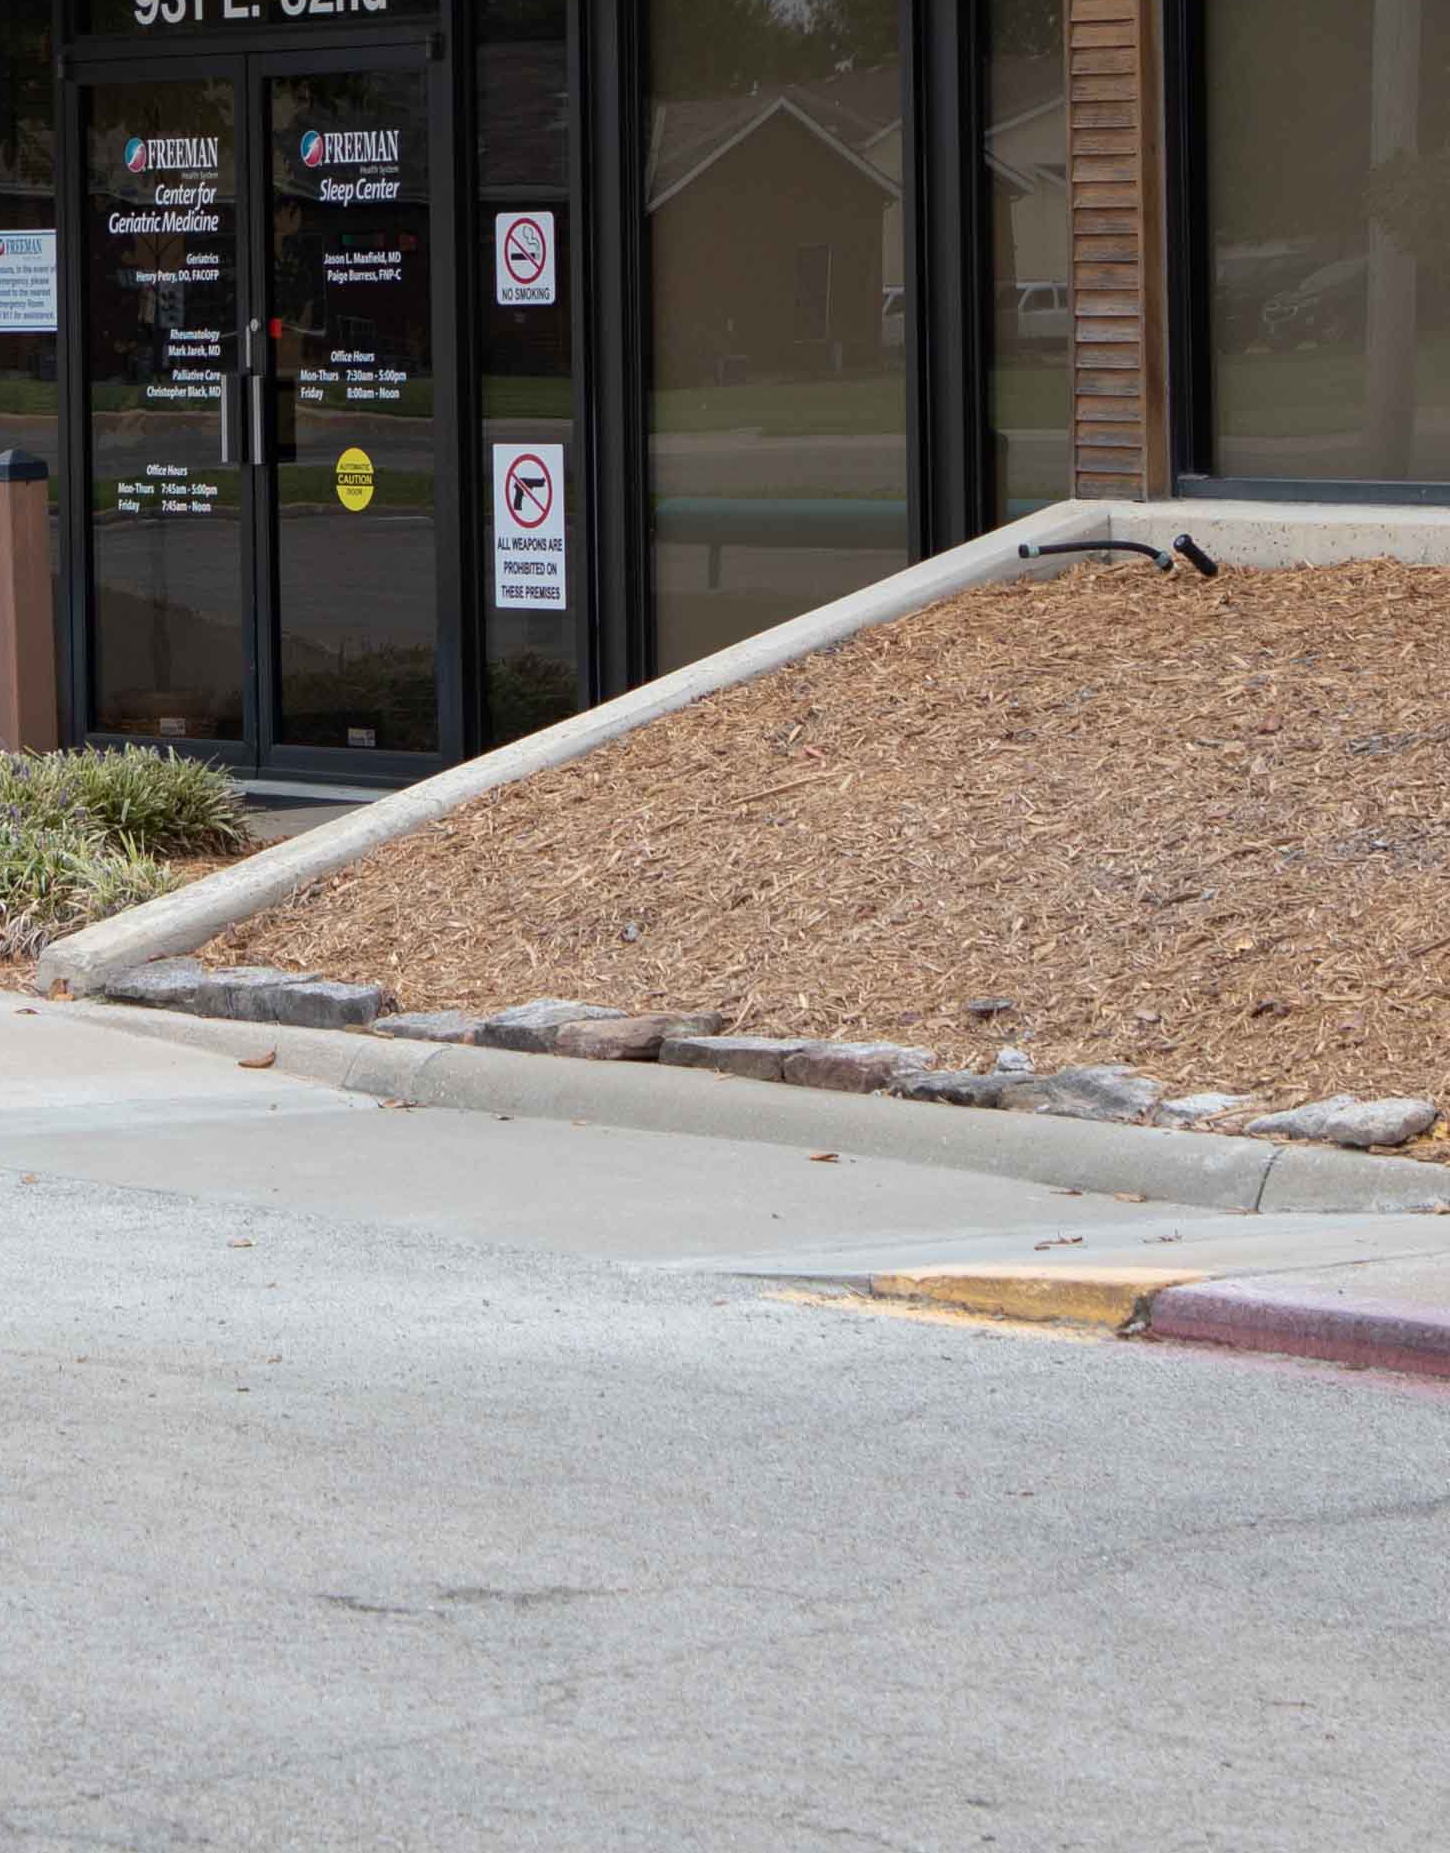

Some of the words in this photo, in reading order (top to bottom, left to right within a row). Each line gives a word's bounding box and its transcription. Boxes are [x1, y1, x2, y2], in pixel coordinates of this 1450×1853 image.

[147, 137, 218, 170] FREEMAN
[324, 131, 399, 164] FREEMAN
[155, 183, 196, 205] Center
[194, 181, 217, 211] for
[319, 177, 354, 207] Sleep
[356, 177, 400, 199] Center
[109, 211, 161, 234] Geriatric
[161, 209, 219, 233] Medicine
[186, 252, 219, 265] Geriatrics
[323, 253, 345, 264] Jason
[388, 251, 402, 263] MD
[136, 271, 156, 284] Henry
[327, 269, 348, 284] Paige
[502, 287, 513, 300] NO
[515, 287, 550, 300] SMOKING
[170, 328, 220, 342] Rheumatology
[168, 345, 186, 356] Mark
[208, 344, 221, 356] MD
[330, 350, 352, 362] Office
[353, 350, 375, 362] Hours
[172, 369, 204, 381] Palliative
[205, 368, 221, 381] Care
[346, 369, 373, 381] 7:30am
[378, 369, 407, 384] 5:00pm
[147, 386, 186, 400] Christopher
[187, 386, 208, 398] Black,
[209, 386, 221, 397] MD
[300, 386, 324, 401] Friday
[379, 387, 400, 399] Noon
[146, 464, 167, 475] Office
[167, 464, 188, 476] Hours
[338, 474, 372, 485] CAUTION
[118, 499, 140, 513] Friday
[192, 500, 212, 512] Noon
[498, 537, 510, 551] ALL
[512, 537, 547, 551] WEAPONS
[548, 538, 563, 552] ARE
[504, 561, 546, 575] PROHIBITED
[546, 562, 557, 575] ON
[501, 585, 524, 599] THESE
[525, 585, 560, 600] PREMISES
